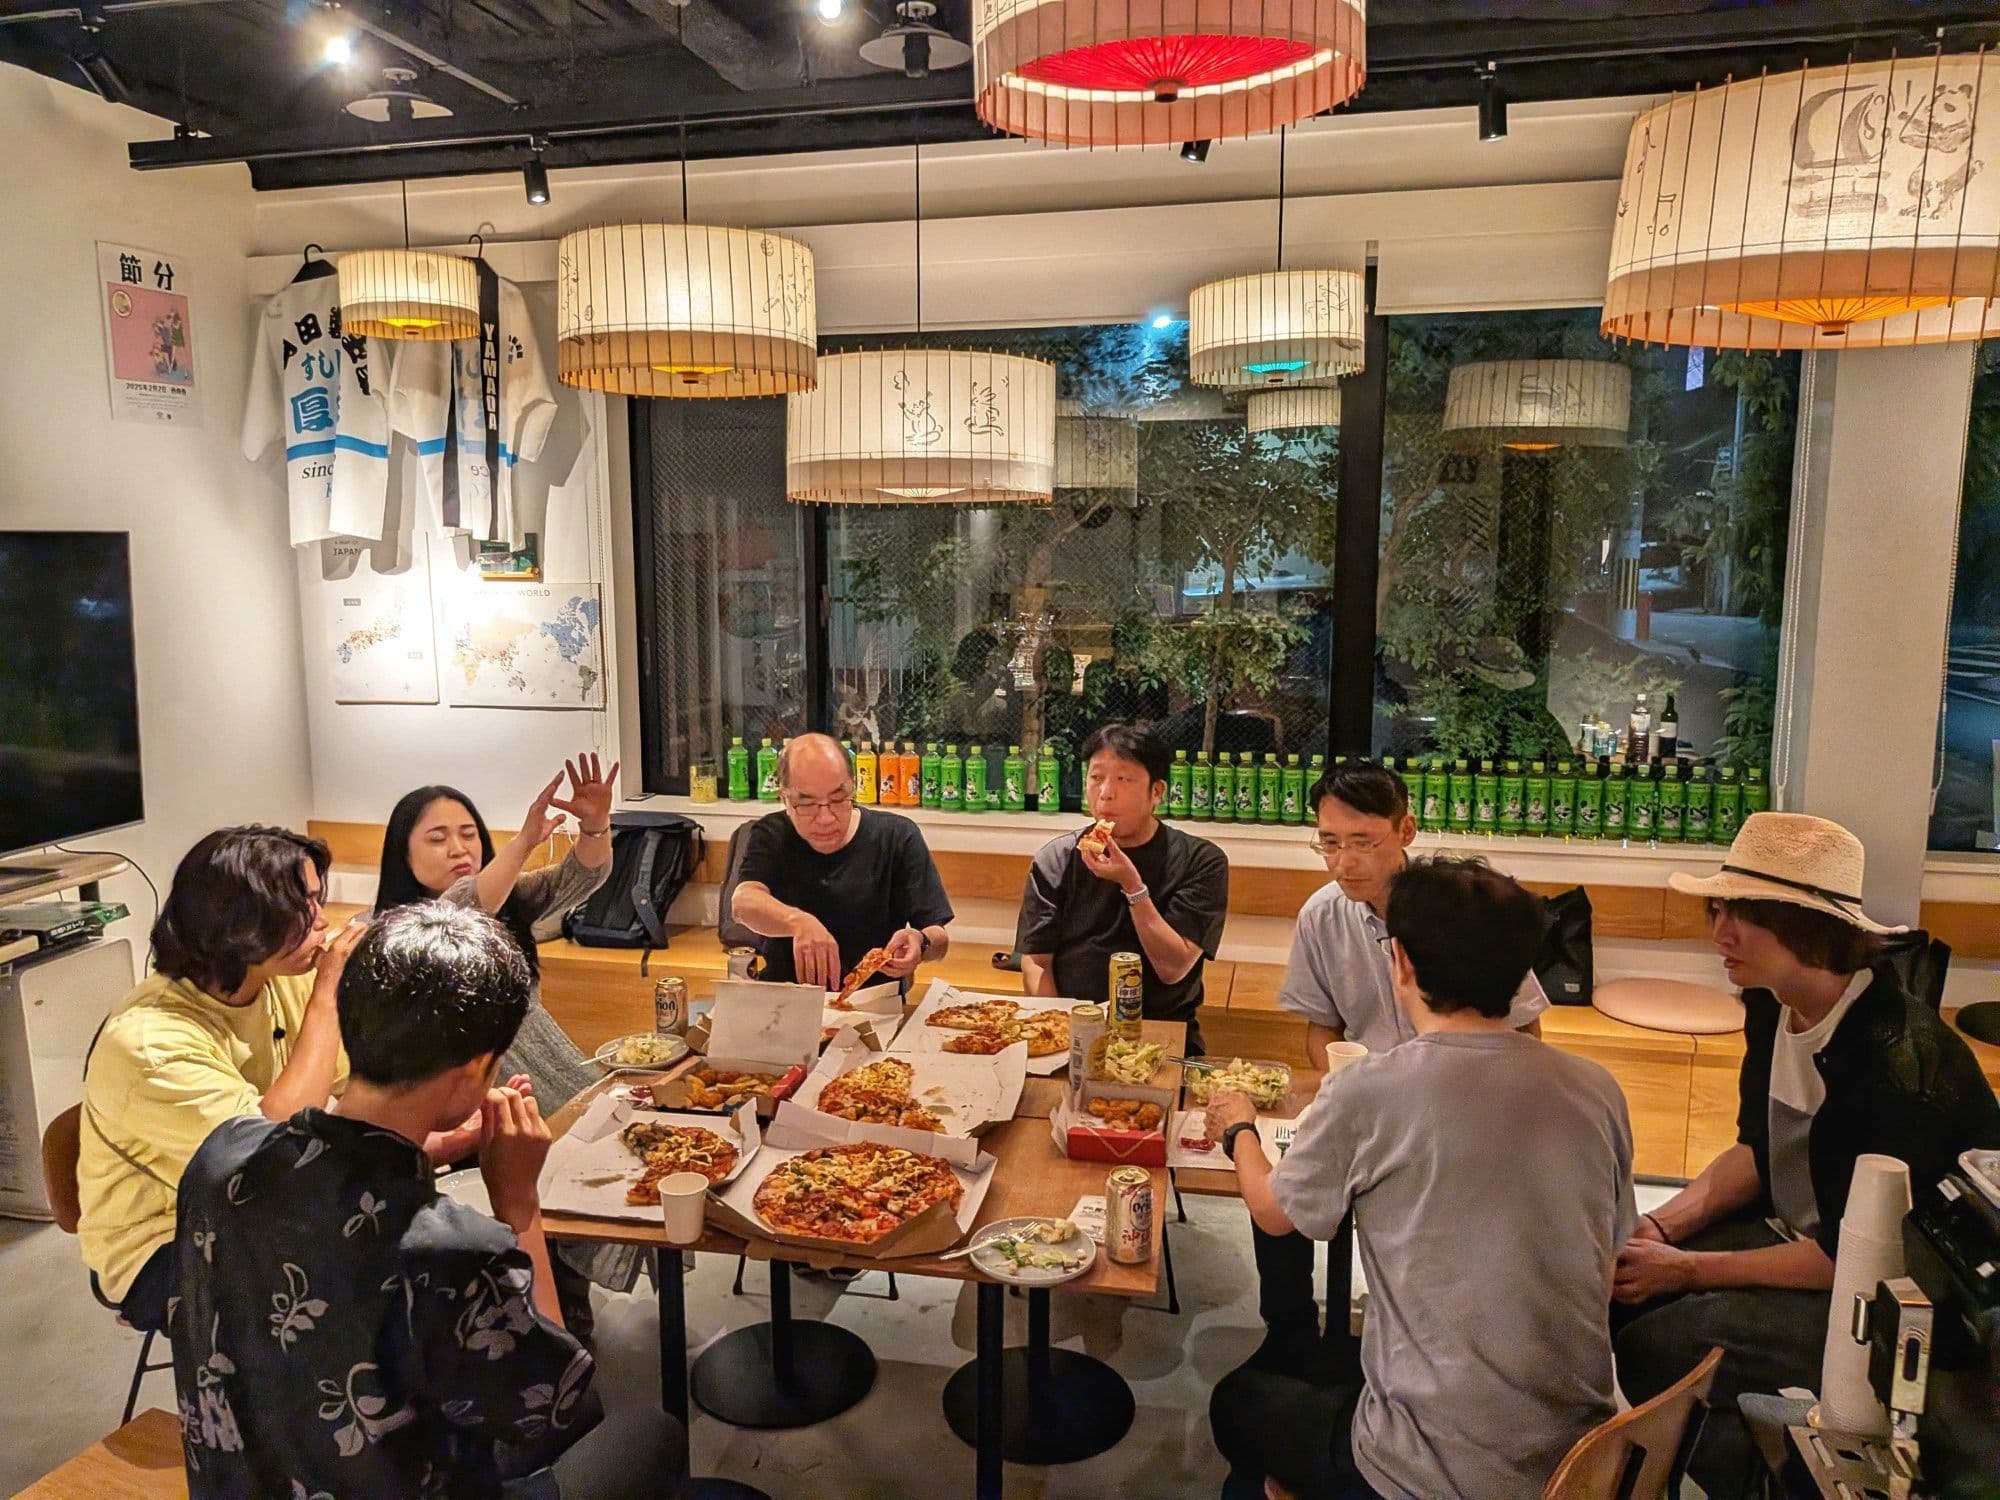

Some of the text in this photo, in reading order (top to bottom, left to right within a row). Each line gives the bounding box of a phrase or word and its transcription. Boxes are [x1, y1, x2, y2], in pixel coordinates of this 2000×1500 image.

[119, 252, 175, 290] 節分
[301, 348, 341, 381] すし
[482, 322, 497, 431] YAMADA
[302, 461, 335, 480] sinc
[519, 589, 551, 597] WORLD
